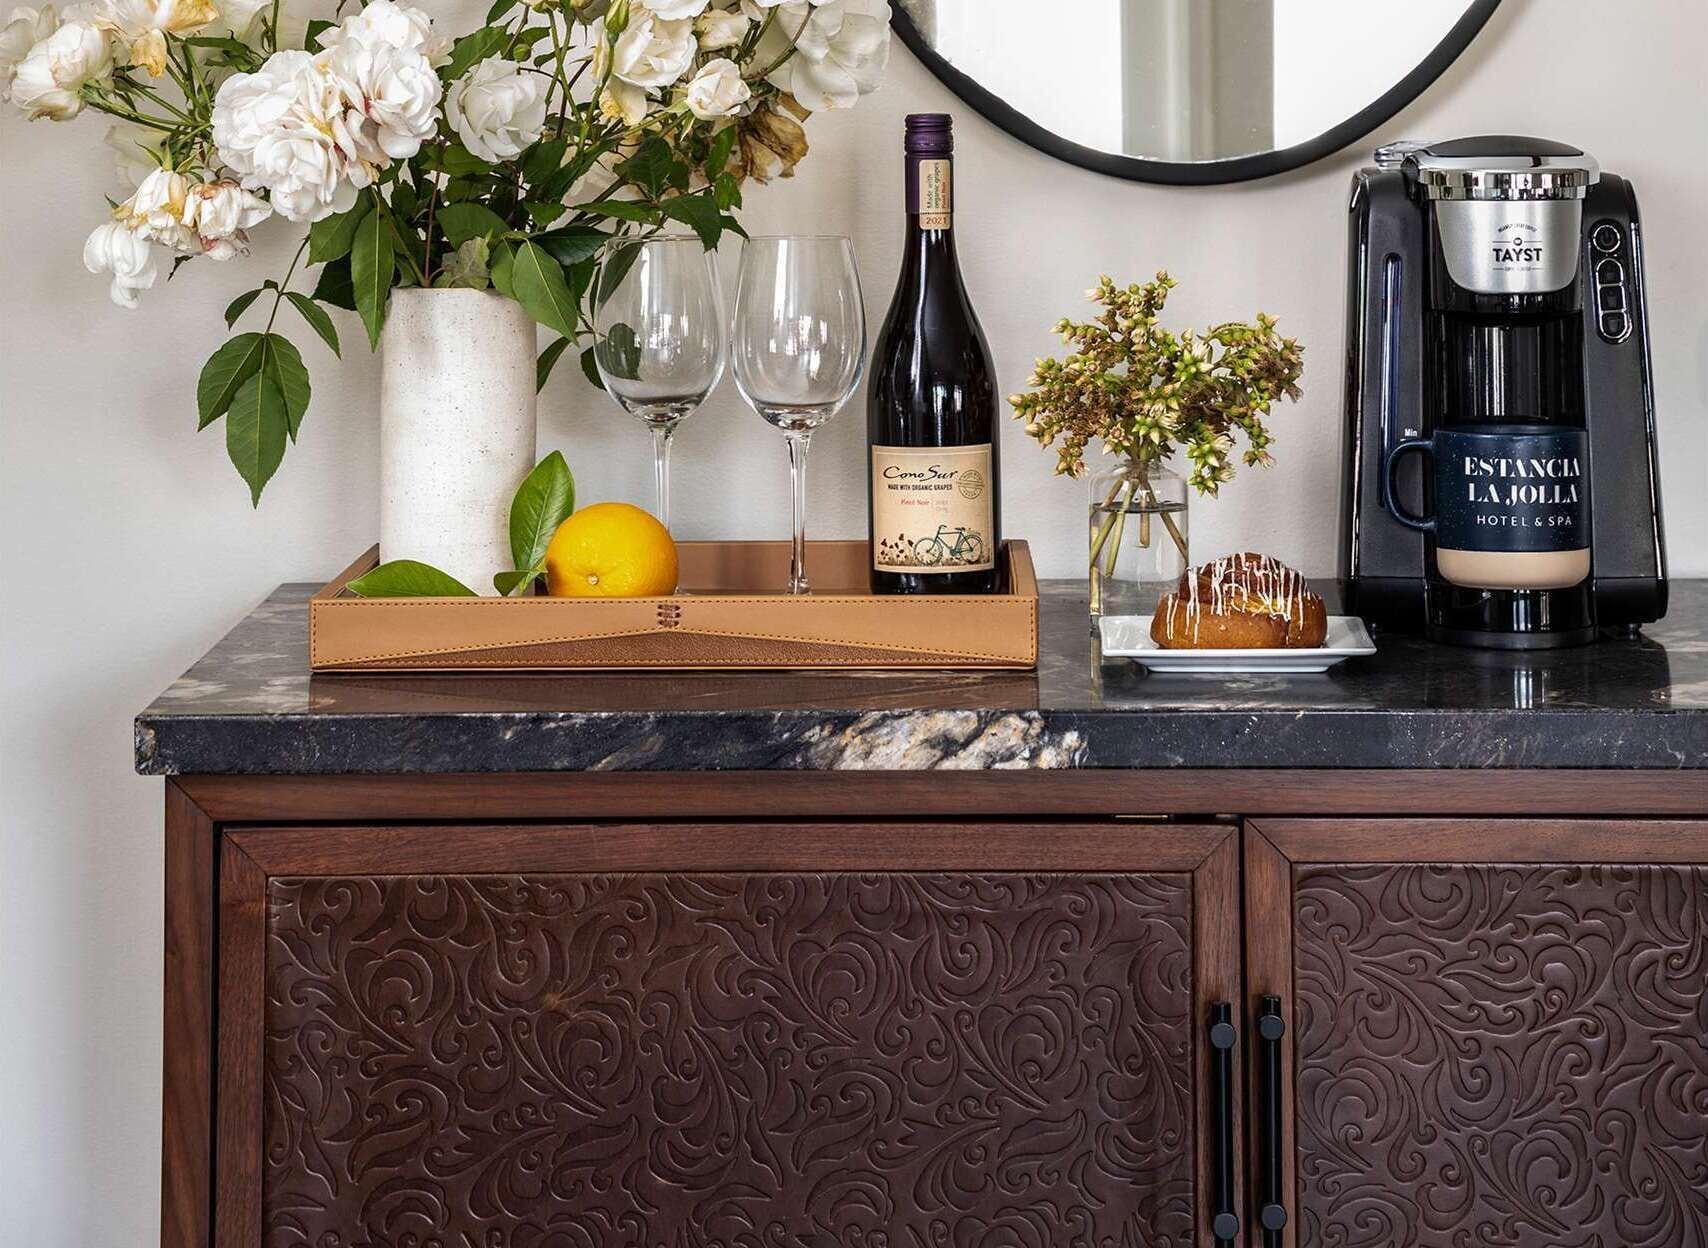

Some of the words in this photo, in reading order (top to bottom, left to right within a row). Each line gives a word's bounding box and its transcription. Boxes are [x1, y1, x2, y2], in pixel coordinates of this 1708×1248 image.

[926, 216, 947, 225] 2021
[1492, 248, 1542, 262] TAYST
[1404, 429, 1418, 437] Min
[883, 465, 924, 480] Cono
[919, 464, 958, 482] Sur
[1464, 456, 1581, 478] ESTANCIA
[1468, 483, 1500, 503] LA
[1505, 484, 1578, 506] JOLLA
[1477, 515, 1530, 527] HOTEL
[1534, 516, 1543, 527] &
[1548, 516, 1572, 527] SPA
